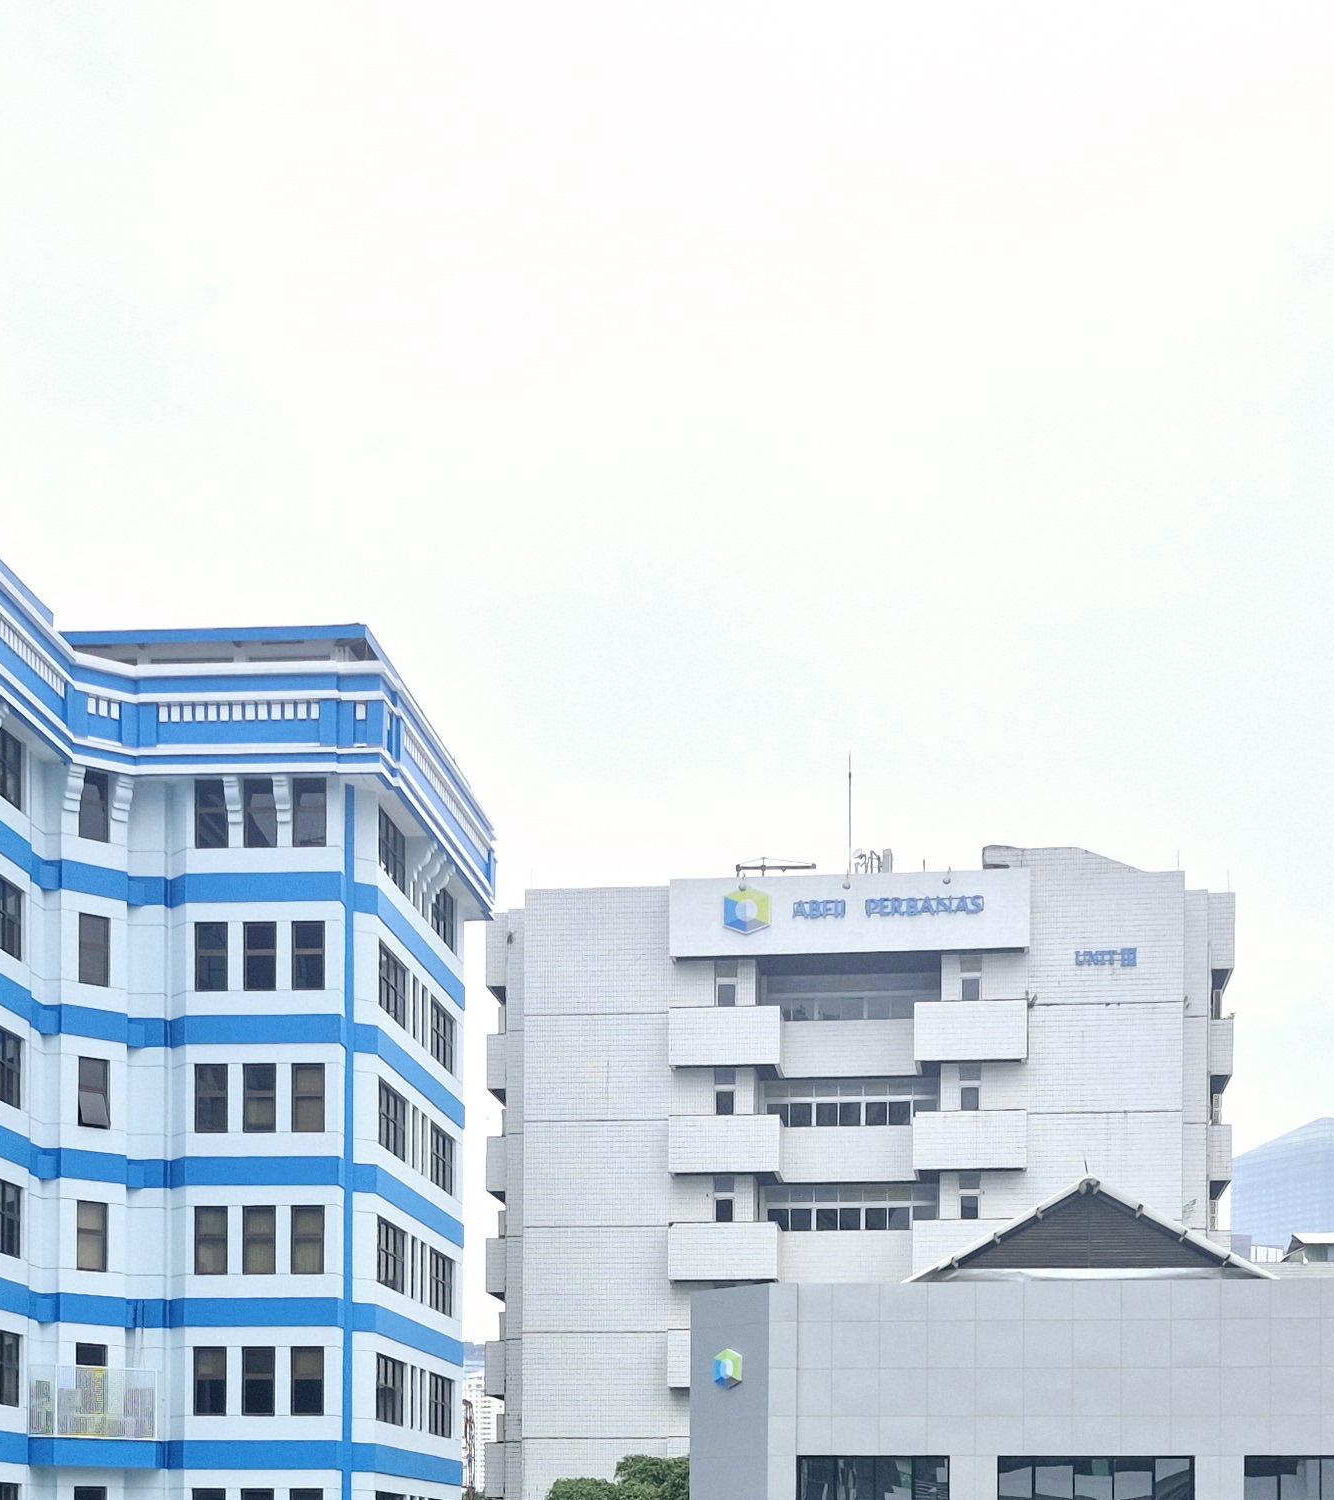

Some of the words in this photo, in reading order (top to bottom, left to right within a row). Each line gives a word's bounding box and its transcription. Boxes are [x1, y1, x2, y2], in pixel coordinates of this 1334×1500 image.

[792, 899, 846, 919] ABFII
[865, 895, 985, 918] PERBANAS
[1075, 950, 1117, 966] UNIT
